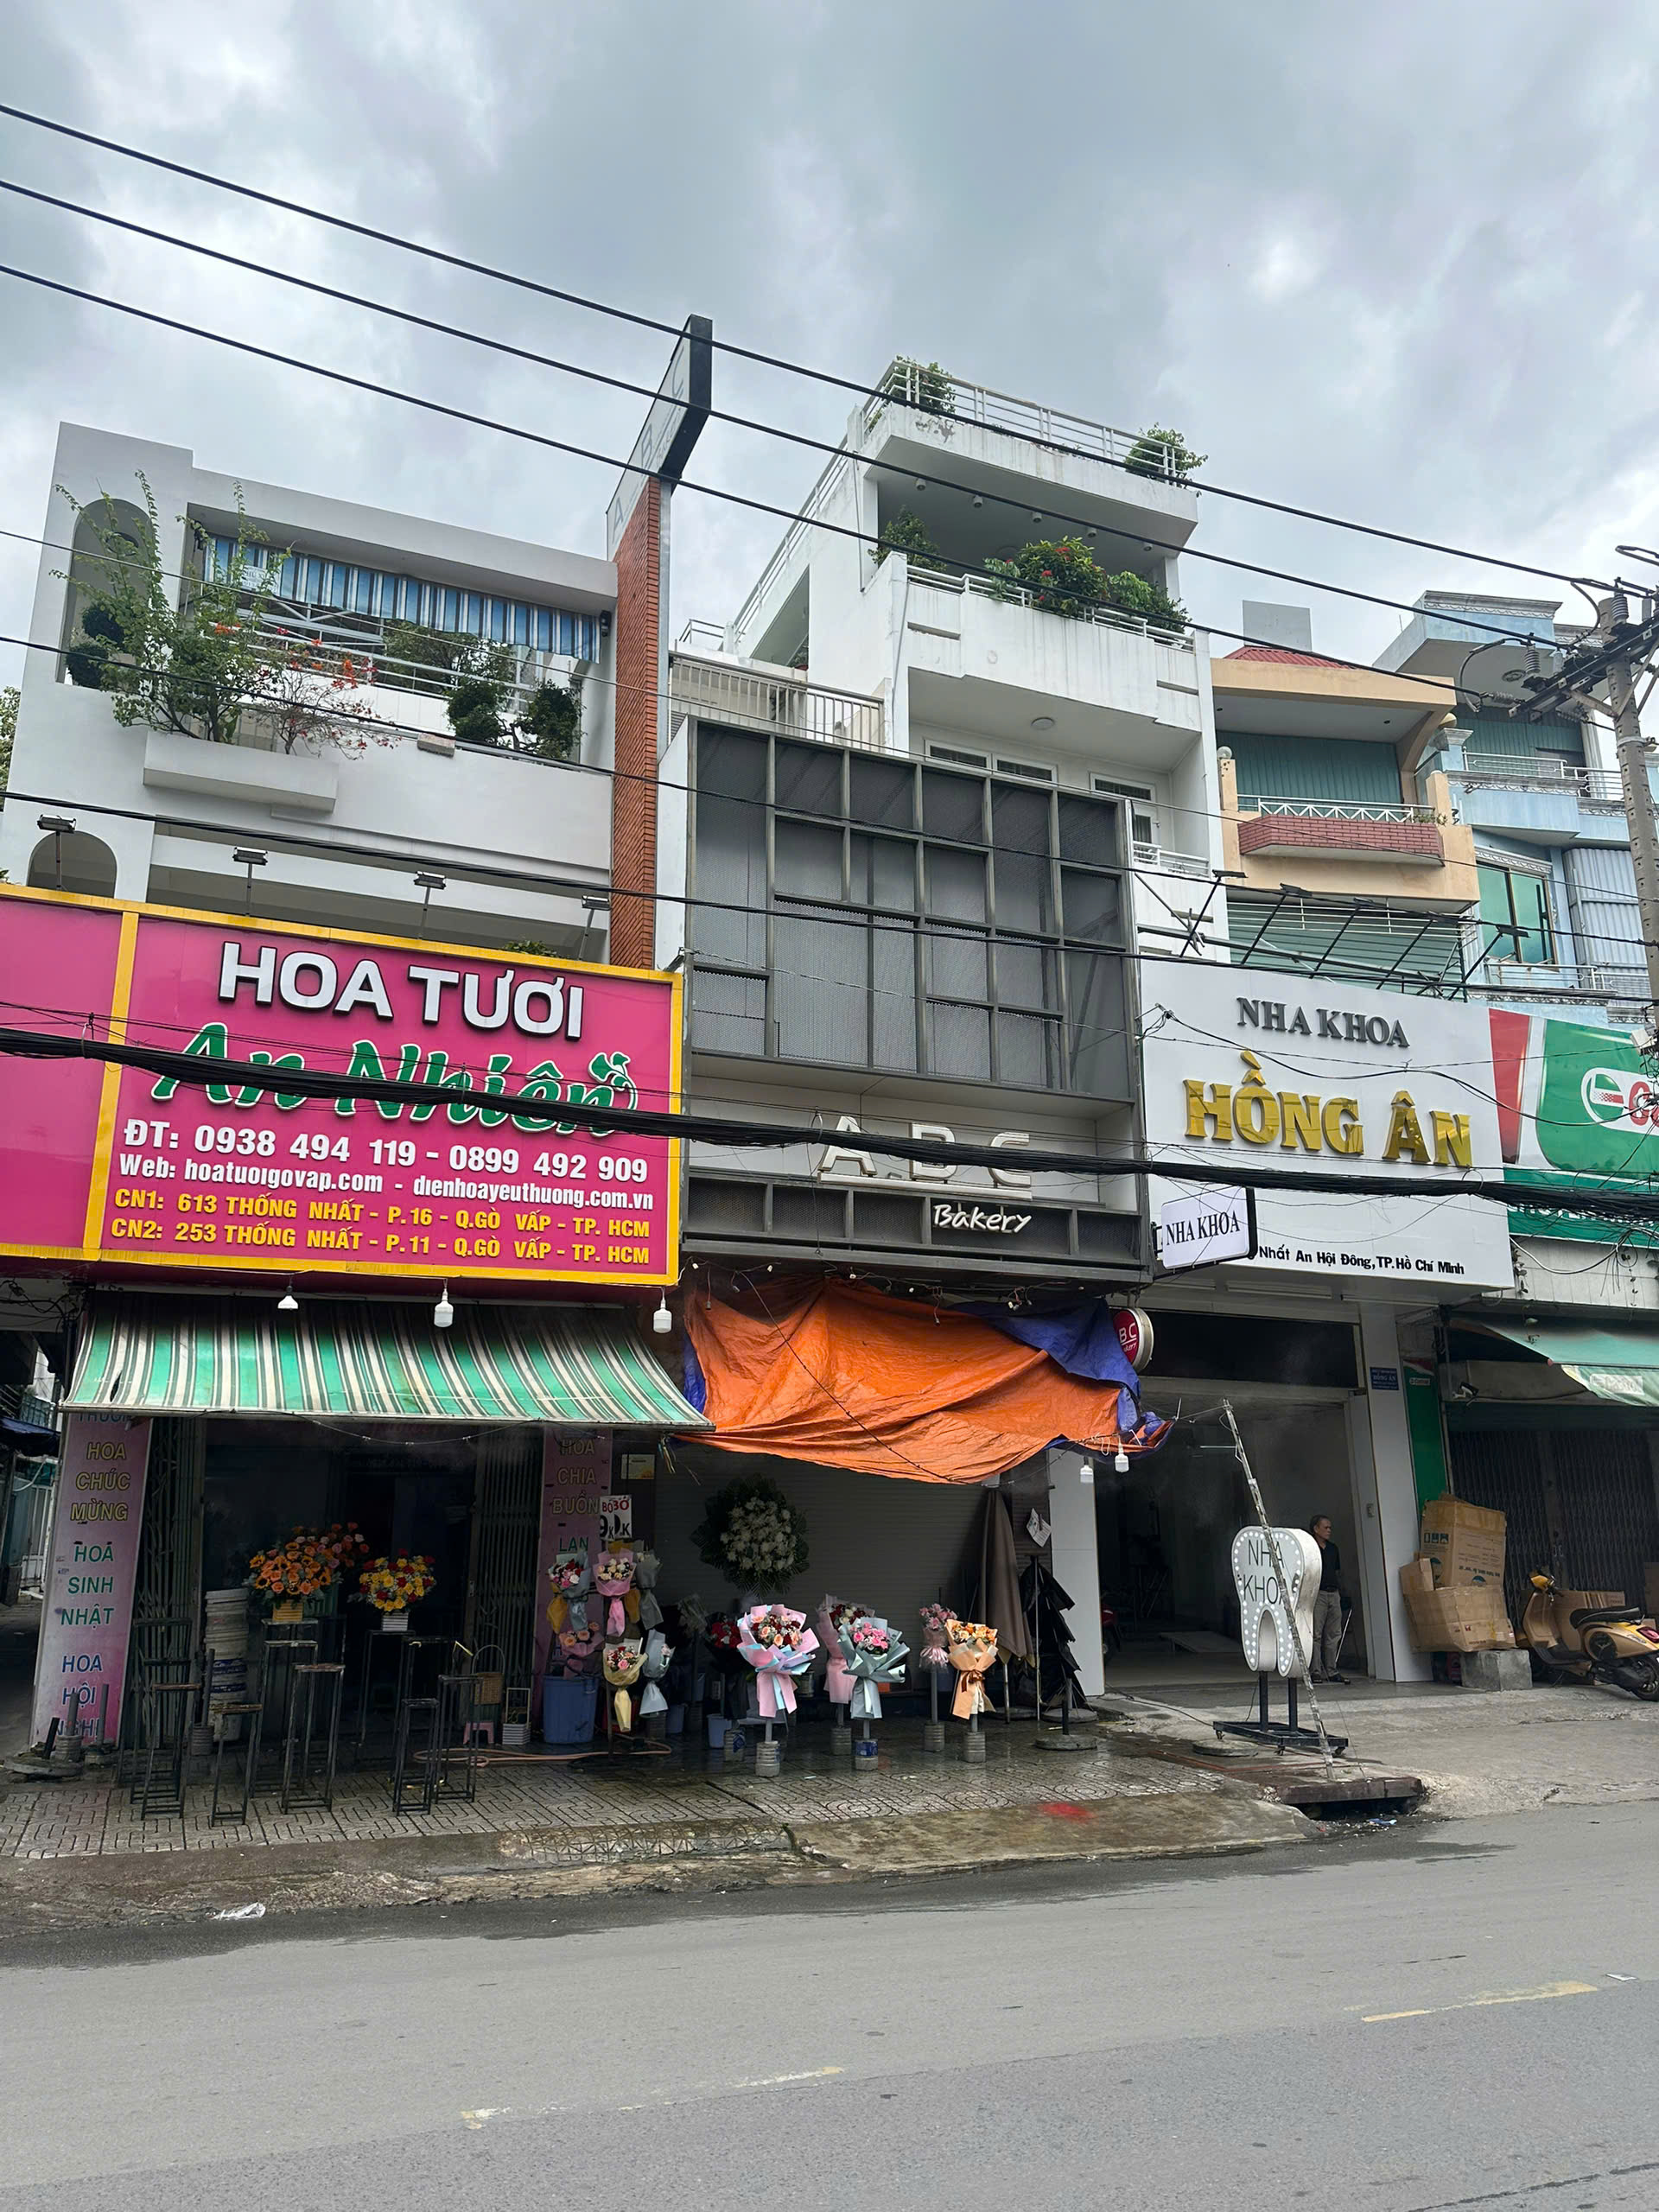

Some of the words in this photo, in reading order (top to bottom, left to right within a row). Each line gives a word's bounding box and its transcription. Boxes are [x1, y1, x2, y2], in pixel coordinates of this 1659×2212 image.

[218, 941, 393, 1020] HOA
[408, 964, 585, 1040] TƯƠI
[1236, 996, 1313, 1035] NHA
[1316, 1008, 1411, 1048] KHOA
[150, 1022, 308, 1109] An
[334, 1039, 635, 1137] Nhiên
[1182, 1050, 1364, 1156] HỒNG
[1382, 1090, 1473, 1167] ÂN
[124, 1118, 179, 1149] ĐT:
[194, 1124, 276, 1157] 0938
[289, 1133, 351, 1162] 494
[369, 1138, 416, 1166] 119
[449, 1145, 520, 1173] 0899
[533, 1152, 588, 1179] 492
[598, 1156, 648, 1183] 909
[119, 1154, 175, 1179] Web:
[184, 1158, 384, 1192] hoatuoigovap.com
[413, 1175, 654, 1211] dienhoayeuthuong.com.vn
[114, 1188, 164, 1210] CN1:
[177, 1193, 218, 1213] 613
[226, 1192, 297, 1218] THỐNG
[308, 1198, 365, 1223] NHẤT
[455, 1207, 501, 1230] Q.GÒ
[515, 1209, 551, 1232] VẤP
[573, 1217, 601, 1236] TP.
[608, 1218, 650, 1238] HCM
[933, 1204, 1032, 1233] Bakery
[111, 1217, 162, 1240] CN2:
[175, 1222, 217, 1243] 253
[224, 1220, 296, 1247] THỐNG
[307, 1226, 363, 1250] NHẤT
[454, 1236, 500, 1259] Q.GÒ
[513, 1236, 551, 1260] VẤP
[572, 1243, 601, 1262] TP.
[607, 1245, 650, 1265] HCM
[1166, 1219, 1196, 1246] NHA
[1197, 1210, 1241, 1240] KHOA
[1259, 1244, 1290, 1261] Nhất
[1296, 1250, 1313, 1263] An
[1317, 1251, 1337, 1267] Hội
[1415, 1258, 1433, 1272] Chí
[86, 1441, 127, 1460] HOA
[559, 1439, 595, 1455] HOA
[76, 1468, 131, 1491] CHÚC
[556, 1467, 596, 1485] CHIA
[70, 1497, 129, 1522] MỪNG
[552, 1491, 601, 1515] BUỒN
[74, 1545, 113, 1562] HOA
[559, 1537, 588, 1552] LAN
[68, 1576, 113, 1594] SINH
[1243, 1574, 1282, 1605] KHO
[60, 1603, 114, 1629] NHẬT
[61, 1654, 103, 1673] HOA
[61, 1681, 96, 1708] HỘI
